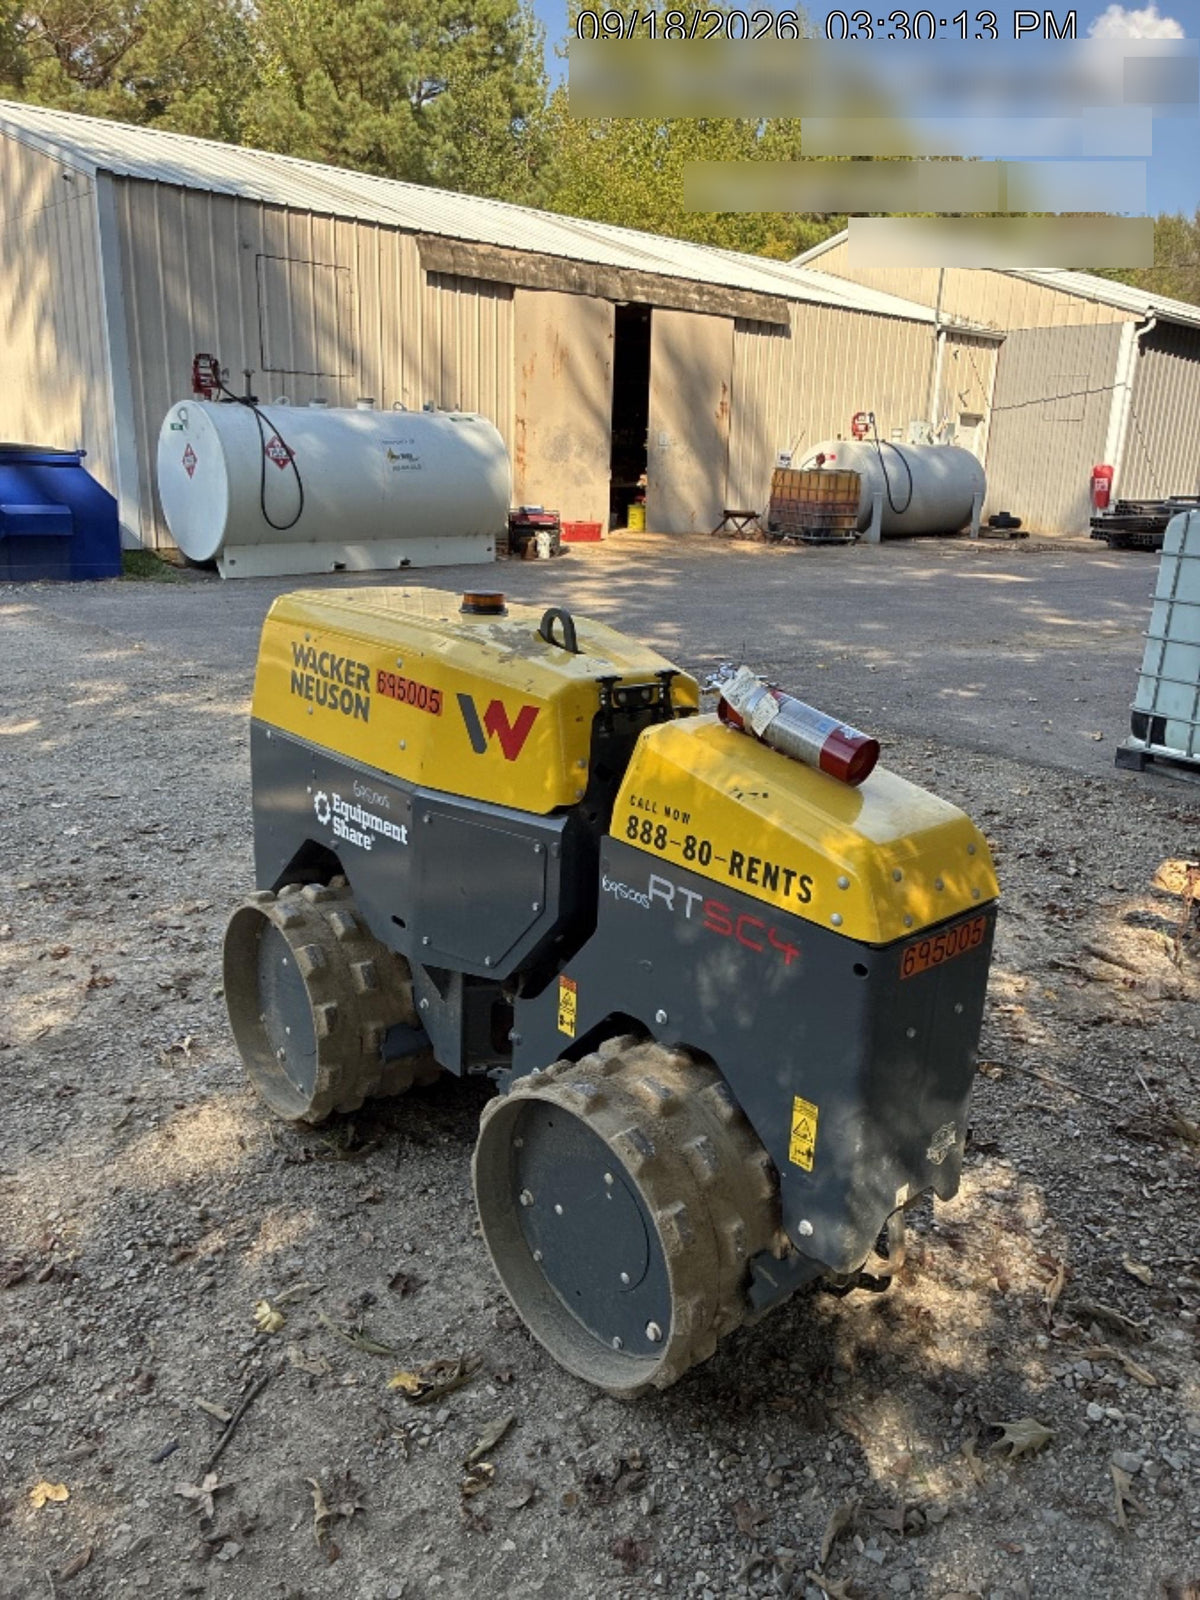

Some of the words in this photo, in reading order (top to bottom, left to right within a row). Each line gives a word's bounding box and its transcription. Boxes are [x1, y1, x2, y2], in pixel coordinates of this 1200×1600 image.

[290, 642, 371, 693] WACKER
[377, 669, 441, 715] 695005
[290, 669, 371, 723] NEUSON
[332, 792, 408, 845] Equipment
[333, 815, 373, 851] Share
[630, 795, 657, 814] CALL
[664, 806, 691, 825] NOW
[626, 815, 814, 904] 888-80-RENTS
[903, 917, 984, 976] 695005
